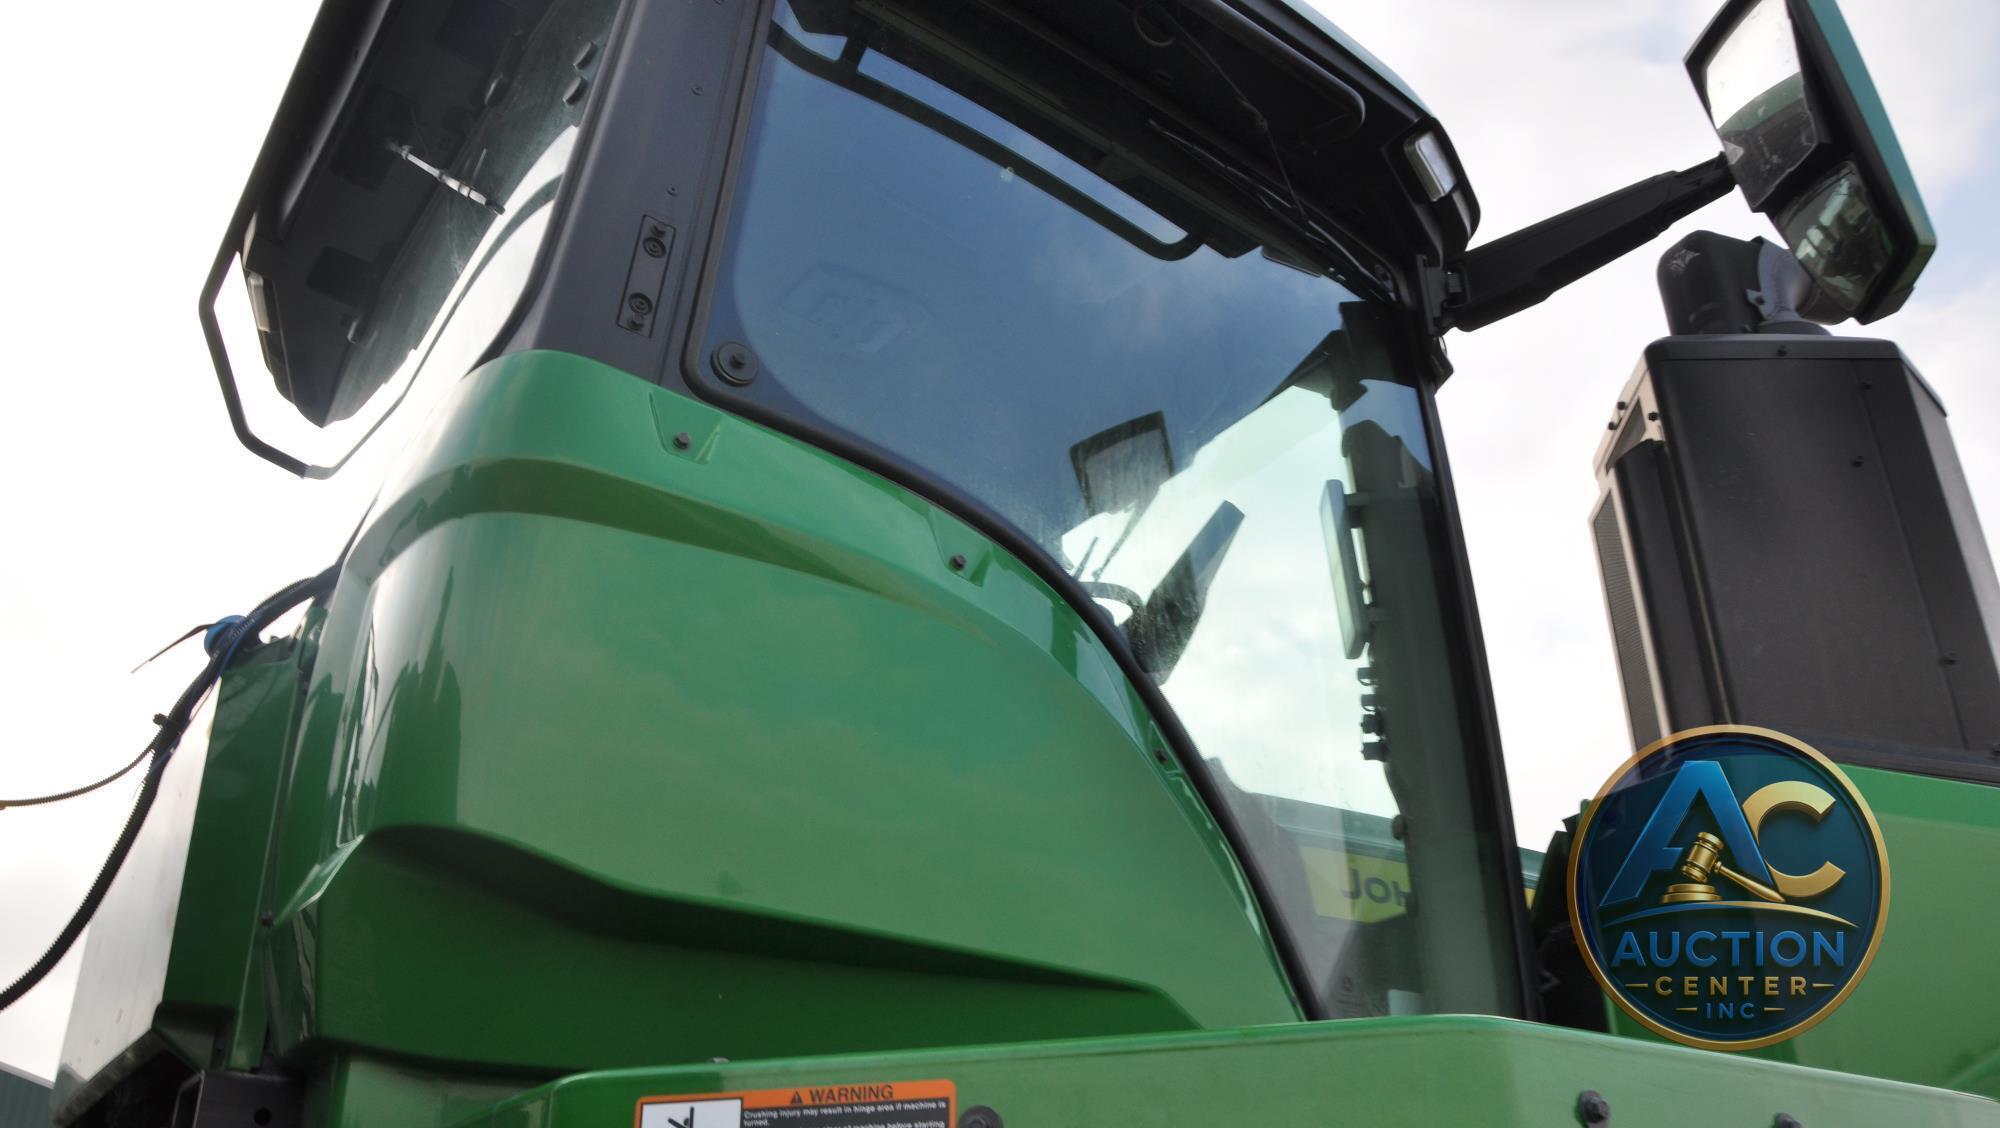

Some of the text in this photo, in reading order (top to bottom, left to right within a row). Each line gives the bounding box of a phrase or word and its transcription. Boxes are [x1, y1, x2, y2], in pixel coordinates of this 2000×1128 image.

[809, 1085, 894, 1104] WARNING
[744, 1110, 778, 1119] Crushing
[780, 1109, 801, 1119] injury
[803, 1108, 818, 1117] may
[820, 1106, 842, 1115] result
[843, 1105, 852, 1113] in
[853, 1105, 875, 1114] hinge
[877, 1104, 895, 1112] area
[903, 1101, 937, 1110] machine
[938, 1100, 946, 1109] is
